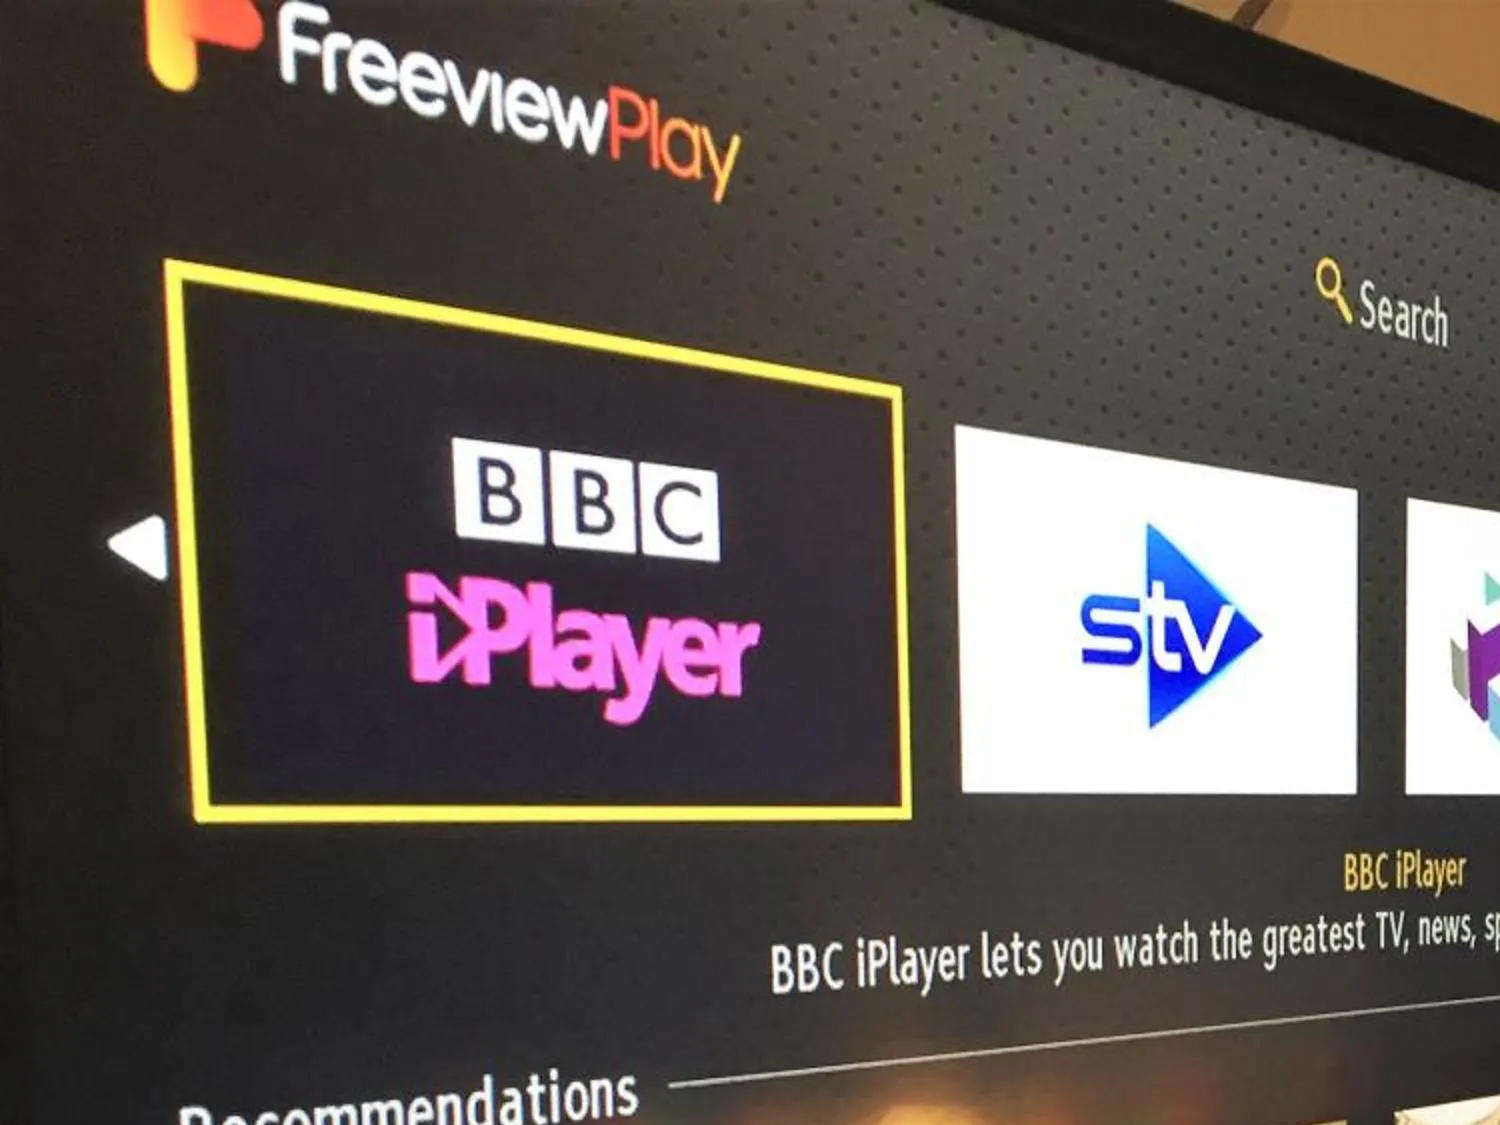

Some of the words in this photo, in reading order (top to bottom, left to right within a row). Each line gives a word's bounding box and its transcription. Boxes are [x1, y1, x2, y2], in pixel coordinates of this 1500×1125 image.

[1359, 278, 1449, 348] Search
[474, 453, 707, 548] BBC
[1343, 851, 1389, 892] BBC
[1395, 848, 1467, 899] iPlayer
[769, 941, 845, 995] BBC
[856, 934, 971, 998] iPlayer
[980, 930, 1043, 979] lets
[1051, 934, 1103, 987] you
[1113, 917, 1199, 969] watch
[1209, 916, 1253, 963] the
[1262, 911, 1366, 972] greatest
[1375, 909, 1411, 955] TV,
[1417, 914, 1477, 950] news,
